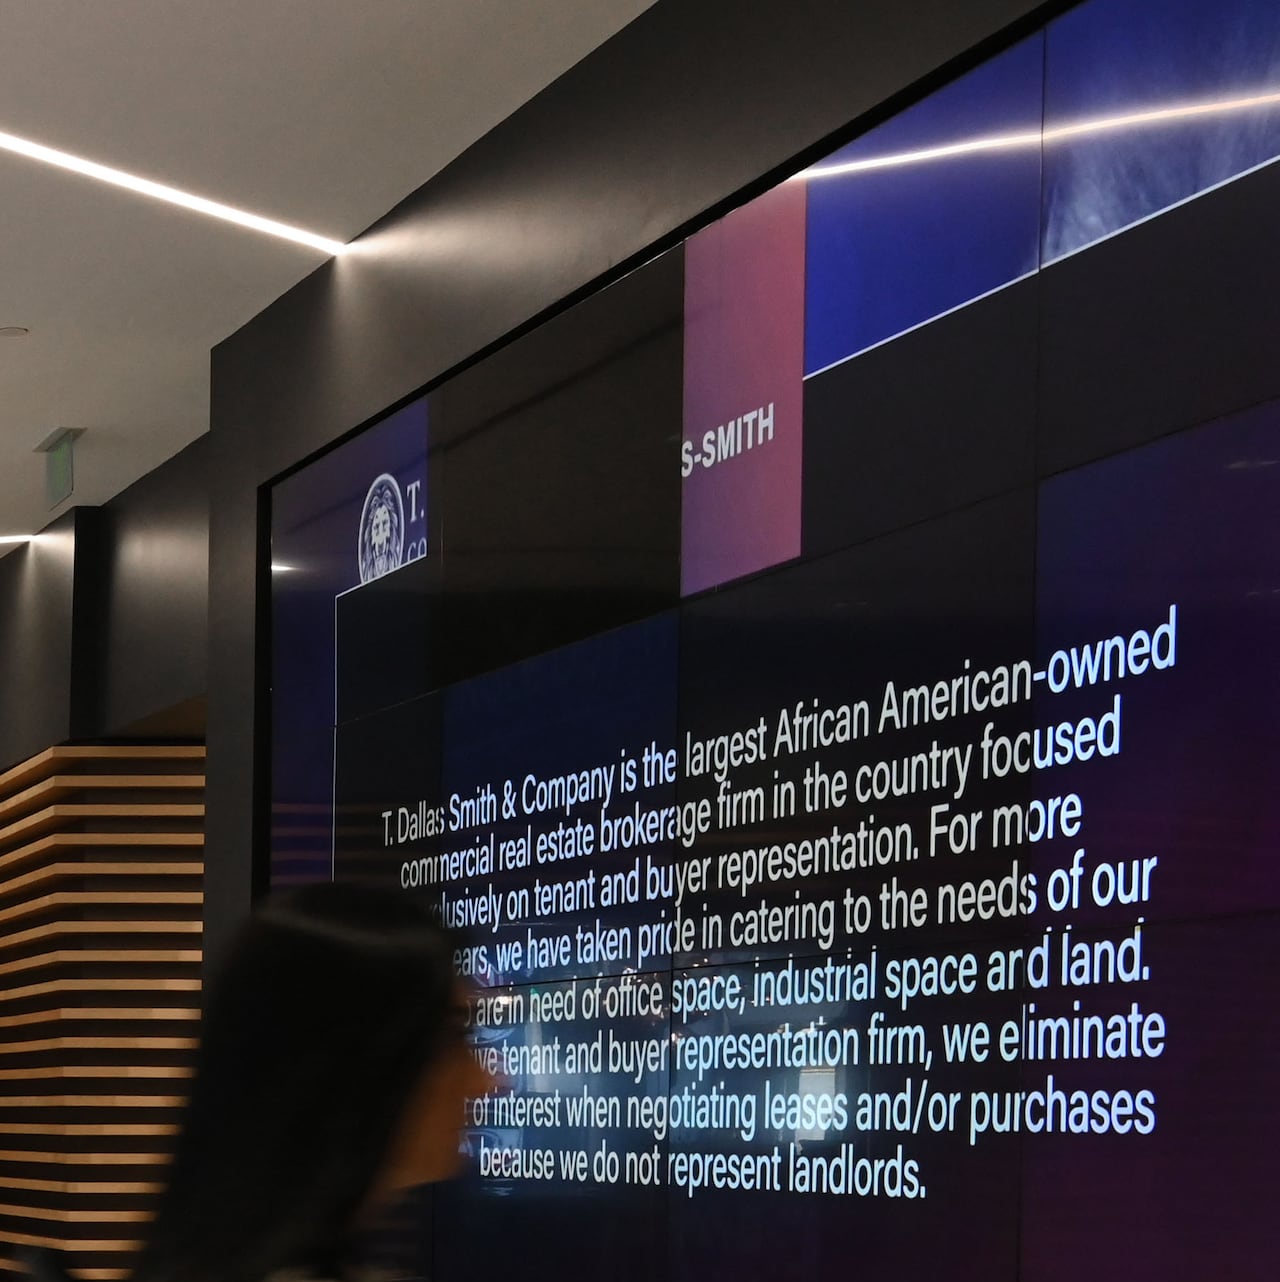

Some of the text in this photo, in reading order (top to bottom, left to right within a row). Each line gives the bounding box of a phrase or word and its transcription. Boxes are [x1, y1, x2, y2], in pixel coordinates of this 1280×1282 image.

[382, 604, 1177, 846] T. Dallas Smith & Company is the largest African American-owned
[400, 694, 1122, 889] commercial real estate brokerage firm in the country focused
[453, 848, 1158, 979] ears, we have taken pride in catering to the needs of our
[506, 888, 529, 921] on
[534, 870, 596, 917] tenant
[600, 856, 639, 907] and
[646, 855, 711, 907] buyer
[718, 814, 919, 897] representation.
[930, 803, 983, 858] For
[992, 793, 1083, 848] more
[476, 996, 503, 1026] are
[508, 982, 524, 1024] in
[529, 975, 576, 1023] need
[581, 972, 603, 1019] of
[605, 969, 663, 1018] office
[672, 974, 746, 1024] space,
[753, 945, 876, 1007] industrial
[885, 952, 977, 1011] space
[1061, 917, 1150, 986] land.
[502, 1036, 560, 1075] tenant
[565, 1029, 602, 1074] and
[608, 1029, 669, 1084] buyer
[676, 1016, 859, 1081] representation
[867, 1012, 933, 1071] firm,
[942, 1021, 989, 1063] we
[999, 1001, 1166, 1061] eliminate
[473, 1092, 490, 1127] of
[493, 1087, 561, 1127] interest
[565, 1085, 620, 1128] when
[627, 1081, 756, 1141] negotiating
[764, 1080, 848, 1131] leases
[856, 1077, 961, 1134] and/or
[969, 1075, 1156, 1146] purchases
[480, 1136, 926, 1199] because we do not represent landlords.
